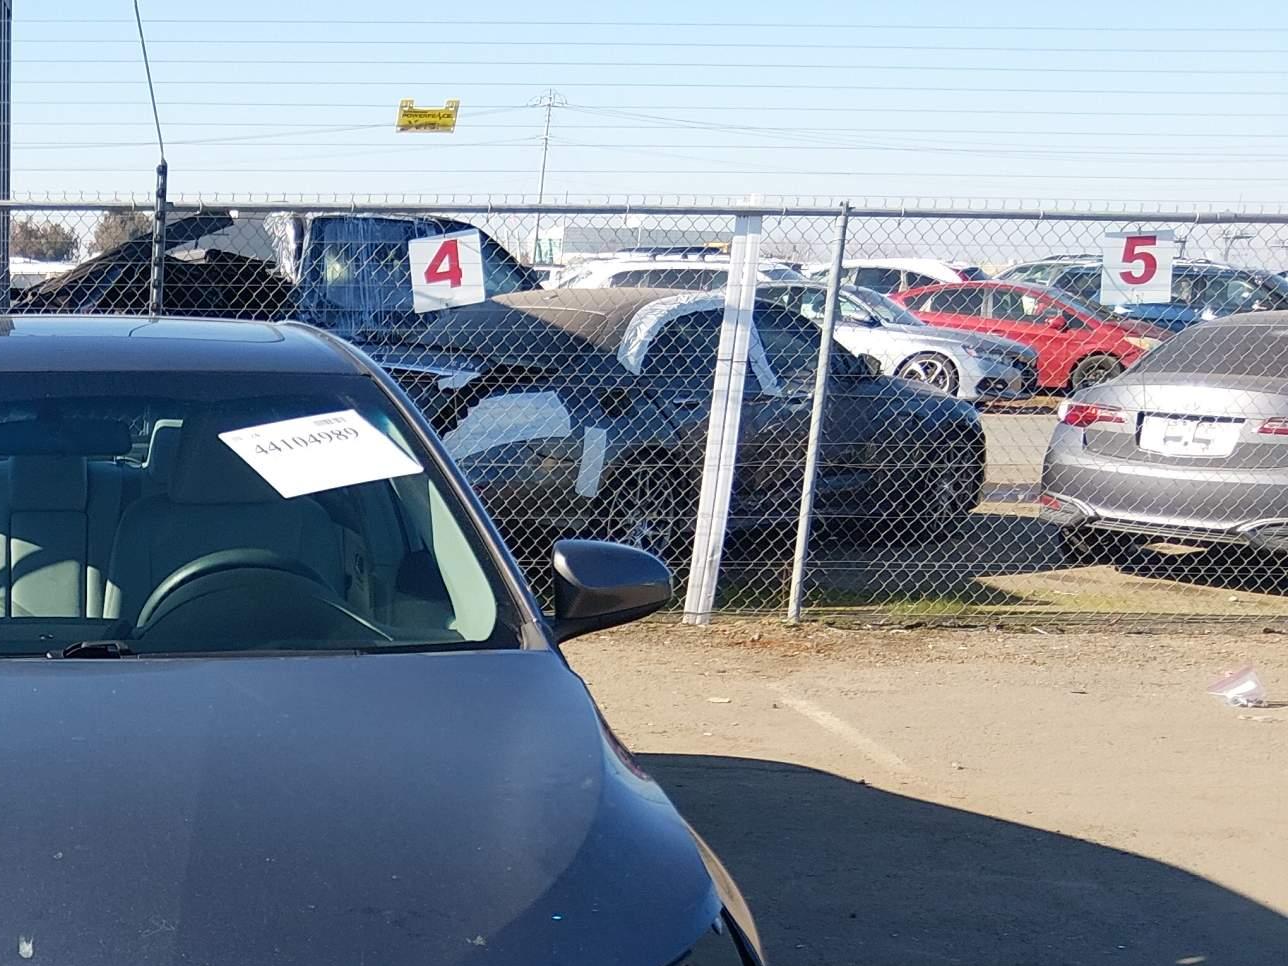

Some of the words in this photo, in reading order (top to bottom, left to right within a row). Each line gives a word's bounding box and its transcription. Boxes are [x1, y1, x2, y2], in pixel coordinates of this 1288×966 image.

[424, 239, 462, 288] 4
[1119, 235, 1158, 285] 5
[255, 427, 360, 455] 44104989
